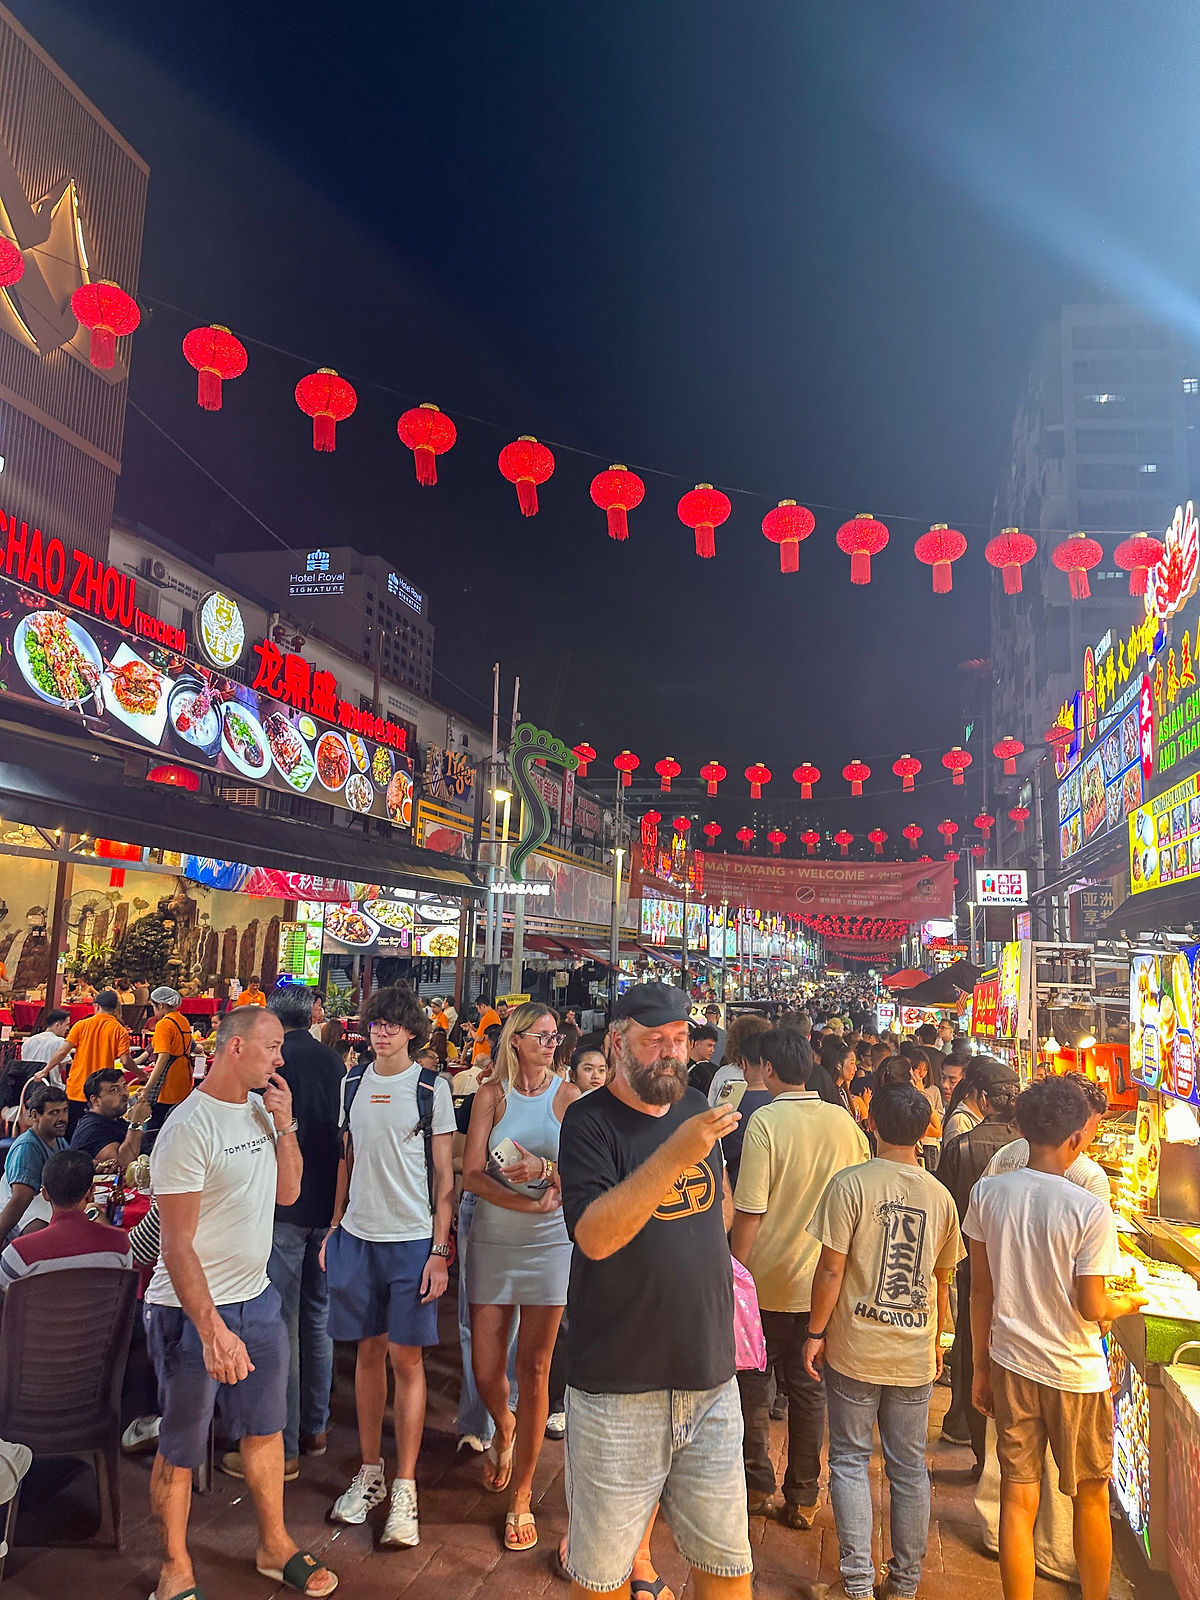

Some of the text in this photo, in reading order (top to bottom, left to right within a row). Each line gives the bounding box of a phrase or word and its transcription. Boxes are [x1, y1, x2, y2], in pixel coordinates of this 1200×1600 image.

[69, 548, 136, 629] ZHOU
[290, 571, 345, 584] Hotel Royal
[290, 585, 344, 594] SIGNATURE
[252, 638, 338, 723] 龙鼎盛
[1158, 703, 1184, 746] ASIAN
[1185, 687, 1200, 723] CH
[1158, 738, 1176, 774] AND
[445, 750, 477, 796] Tiger
[734, 863, 786, 877] DATANG
[798, 867, 866, 881] WELCOME
[490, 882, 551, 896] MASSAGE
[983, 895, 1000, 903] HOME
[1083, 892, 1114, 907] 亚洲
[224, 1142, 251, 1155] TOMMY
[884, 1214, 918, 1300] 八王子
[854, 1301, 928, 1328] HACHIOJI
